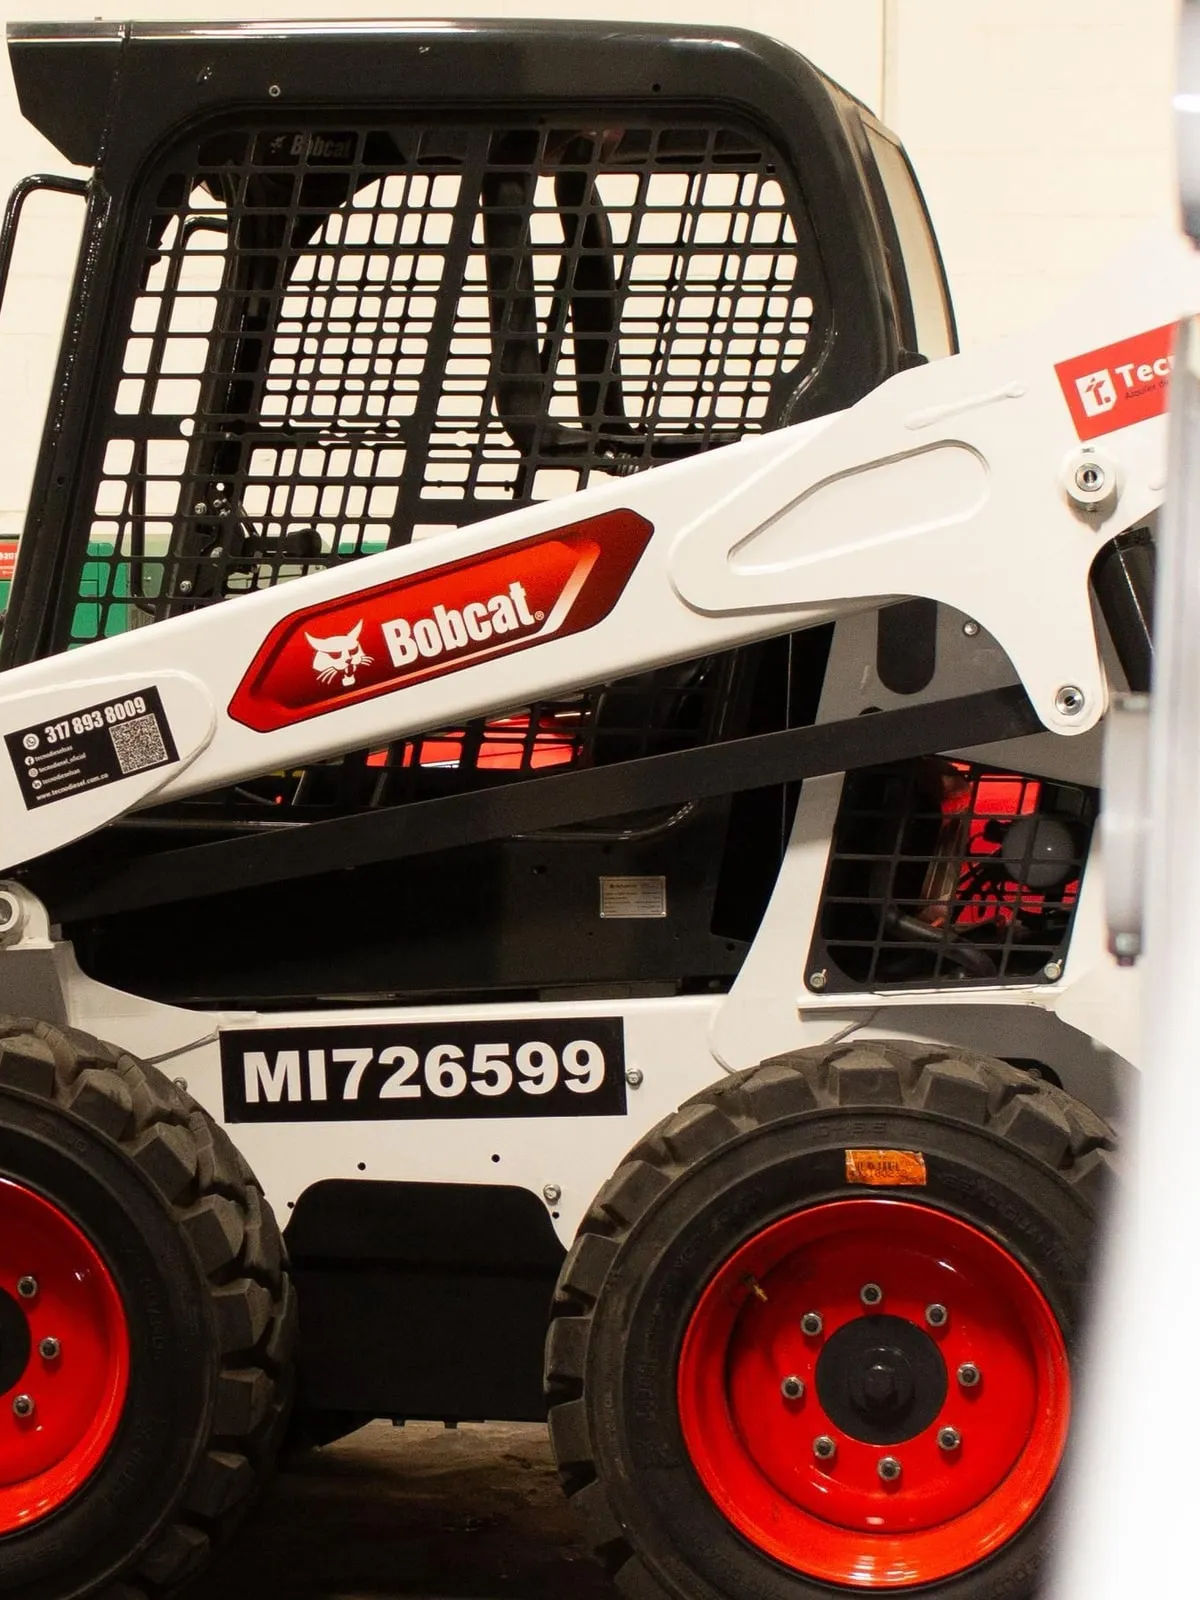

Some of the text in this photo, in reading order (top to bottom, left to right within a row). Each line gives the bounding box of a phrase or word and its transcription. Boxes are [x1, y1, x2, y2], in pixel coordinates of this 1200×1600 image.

[44, 696, 147, 744] 317 893 8009
[36, 772, 109, 801] www.tecnodiesel.com.co
[243, 1040, 606, 1104] MI726599
